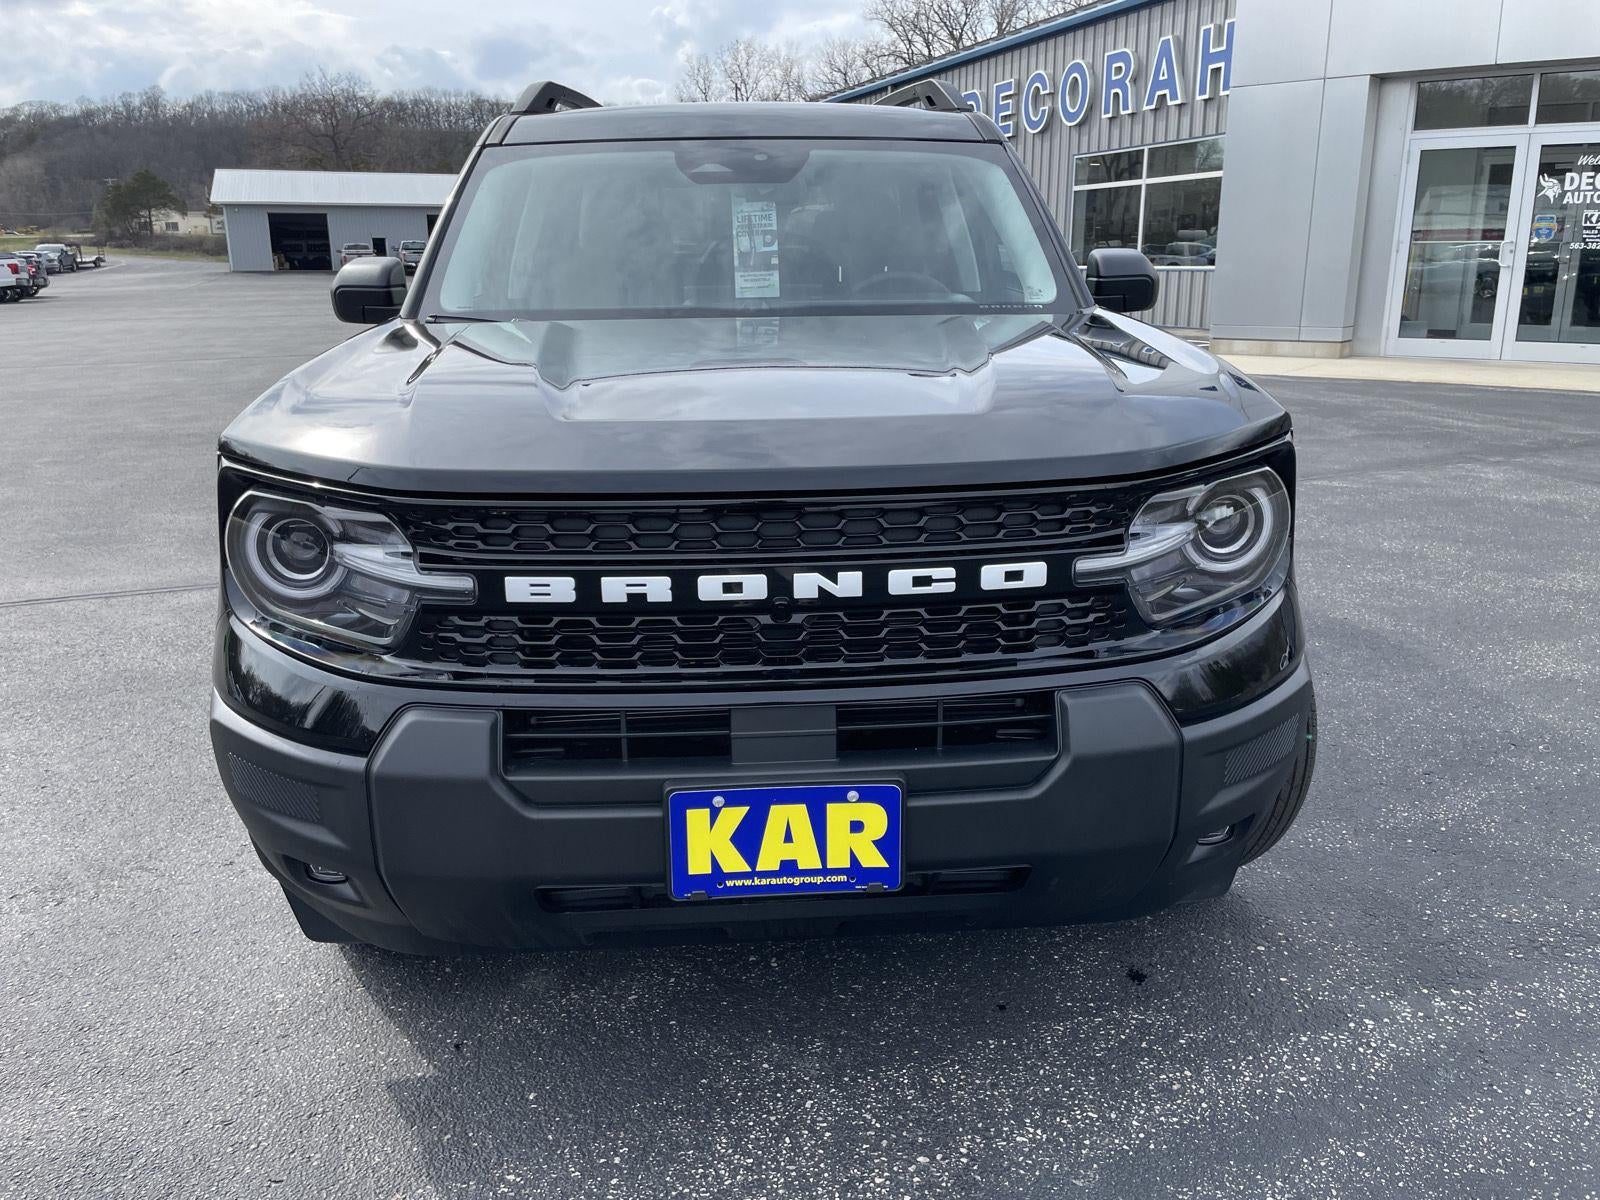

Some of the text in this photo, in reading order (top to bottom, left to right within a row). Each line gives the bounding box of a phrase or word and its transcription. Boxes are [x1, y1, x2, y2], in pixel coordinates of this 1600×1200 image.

[1577, 155, 1600, 166] Wel
[504, 561, 1047, 603] BRONCO
[685, 802, 890, 875] KAR
[725, 874, 848, 888] www.karautogroup.com
